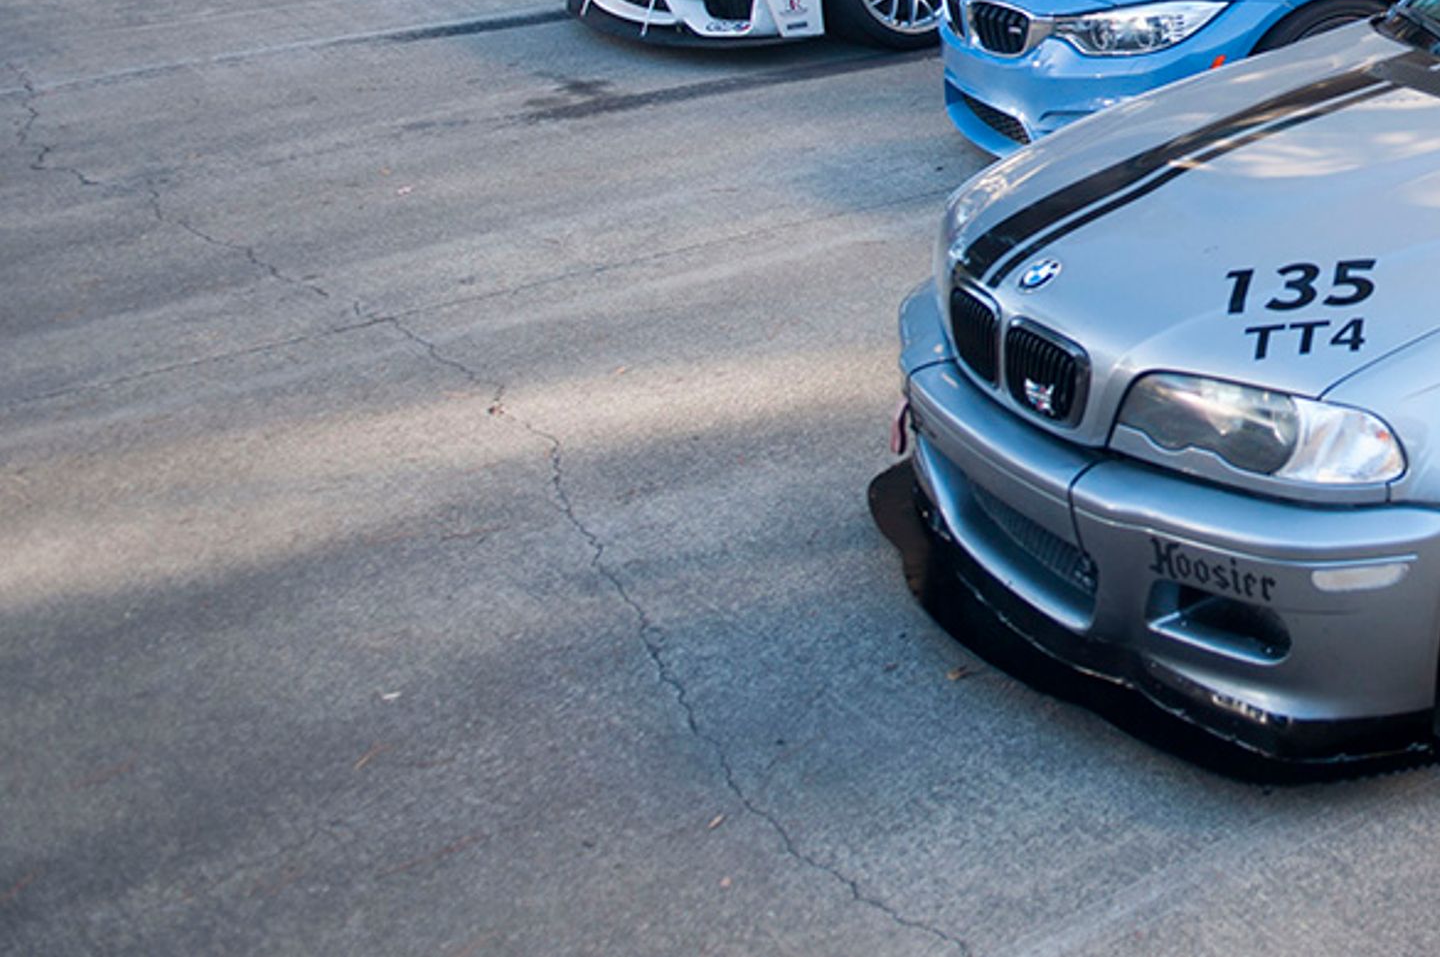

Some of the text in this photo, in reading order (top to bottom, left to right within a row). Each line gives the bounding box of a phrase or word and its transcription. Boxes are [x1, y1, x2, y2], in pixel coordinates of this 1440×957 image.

[1225, 258, 1377, 316] 135
[1244, 316, 1366, 361] TT4
[1149, 536, 1277, 602] Hoosier
